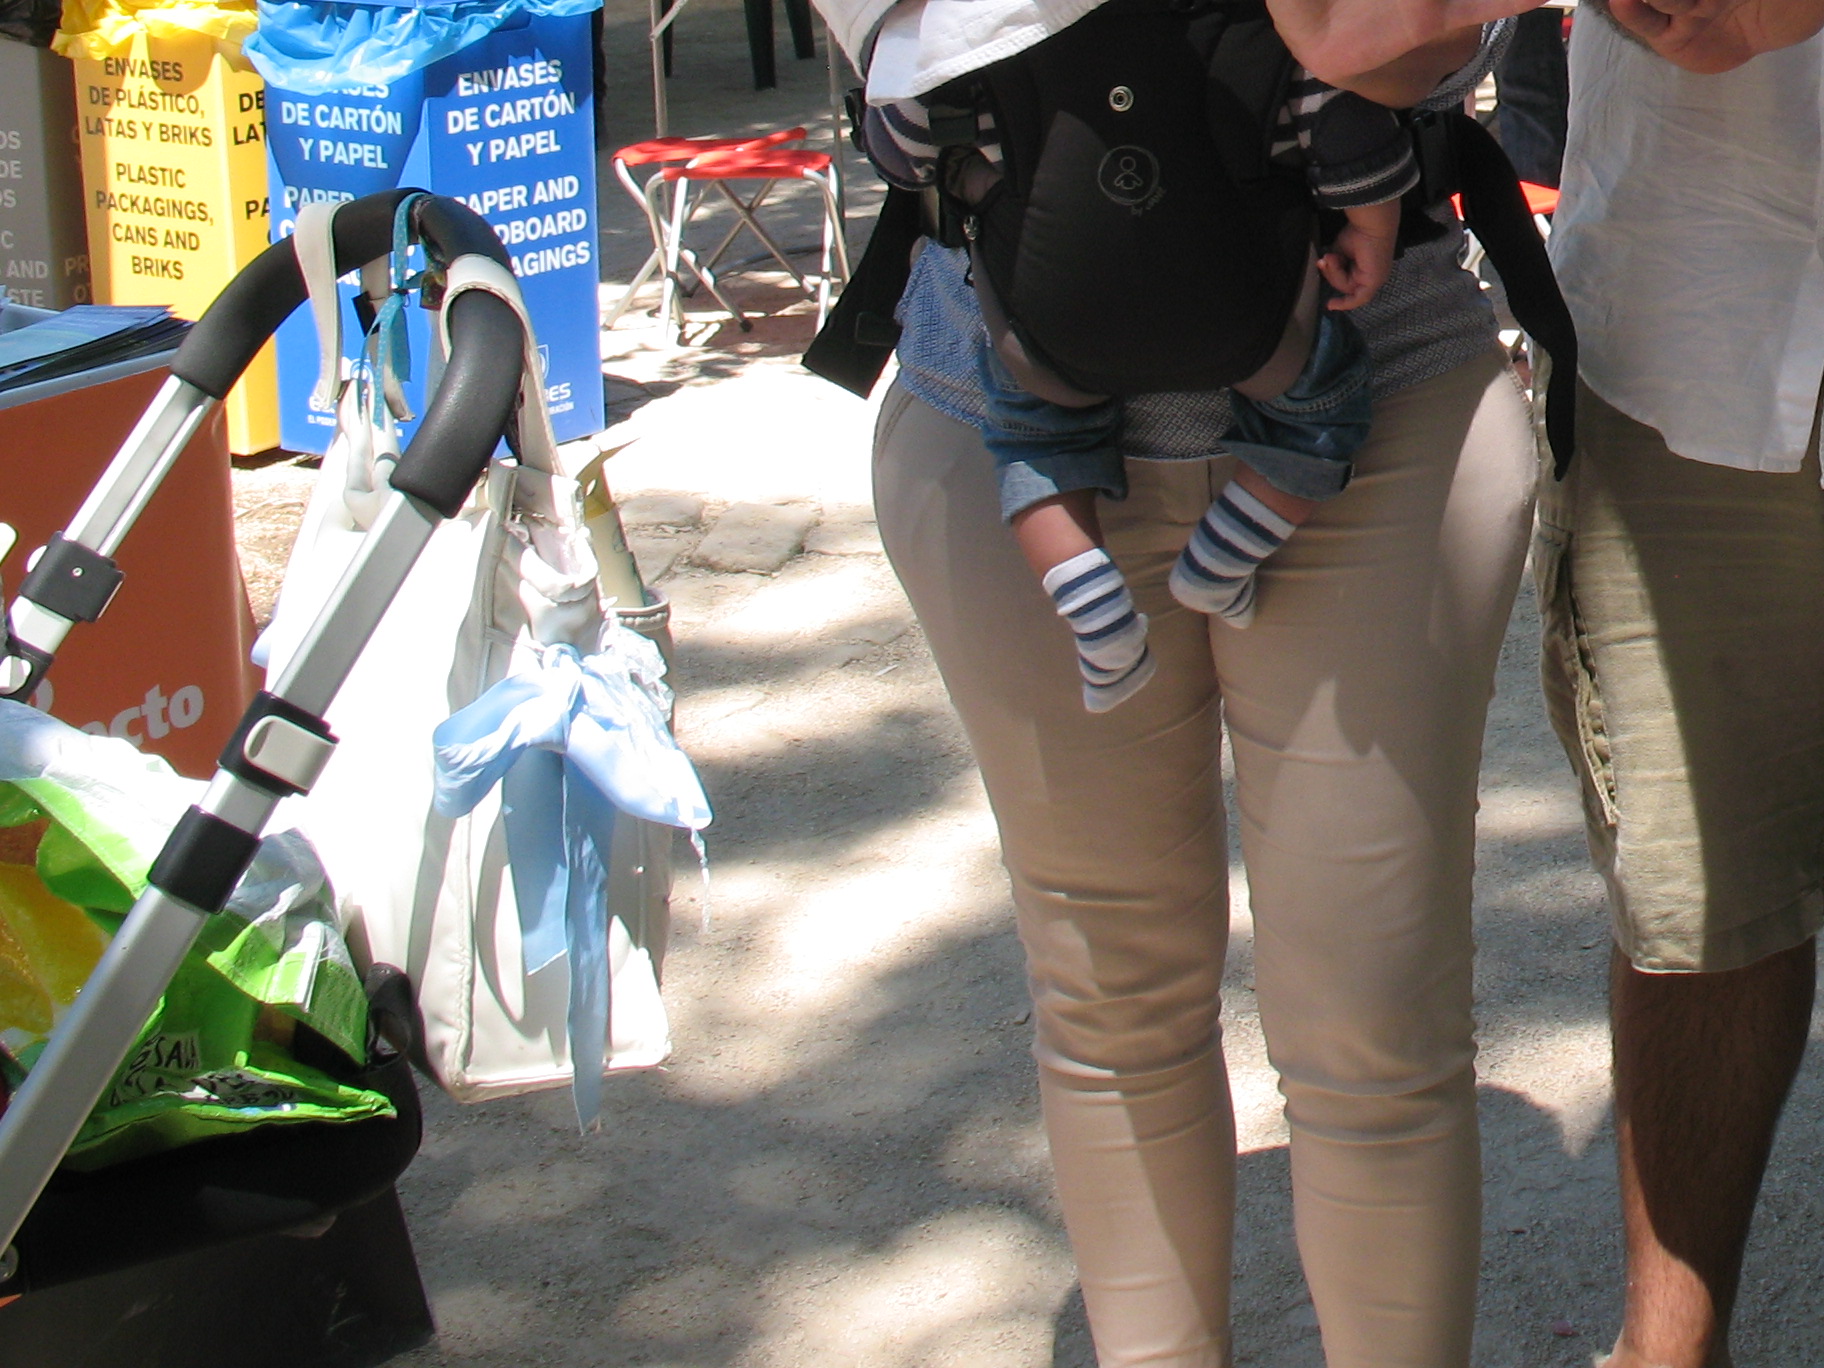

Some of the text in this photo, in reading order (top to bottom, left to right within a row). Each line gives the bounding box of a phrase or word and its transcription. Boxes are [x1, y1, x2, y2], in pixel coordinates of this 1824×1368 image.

[103, 56, 184, 83] ENVASES
[457, 59, 562, 97] ENVASES
[88, 85, 206, 119] DE PLÁSTICO,
[281, 101, 402, 135] DE CARTÓN
[447, 89, 575, 134] DE CARTÓN
[84, 116, 213, 148] LATAS Y BRIKS
[467, 129, 561, 166] Y PAPEL
[299, 137, 388, 169] Y PAPEL
[115, 162, 187, 189] PLASTIC
[532, 175, 579, 205] AND
[95, 190, 215, 227] PACKAGINGS,
[112, 222, 200, 252] CANS AND
[131, 254, 185, 281] BRIKS
